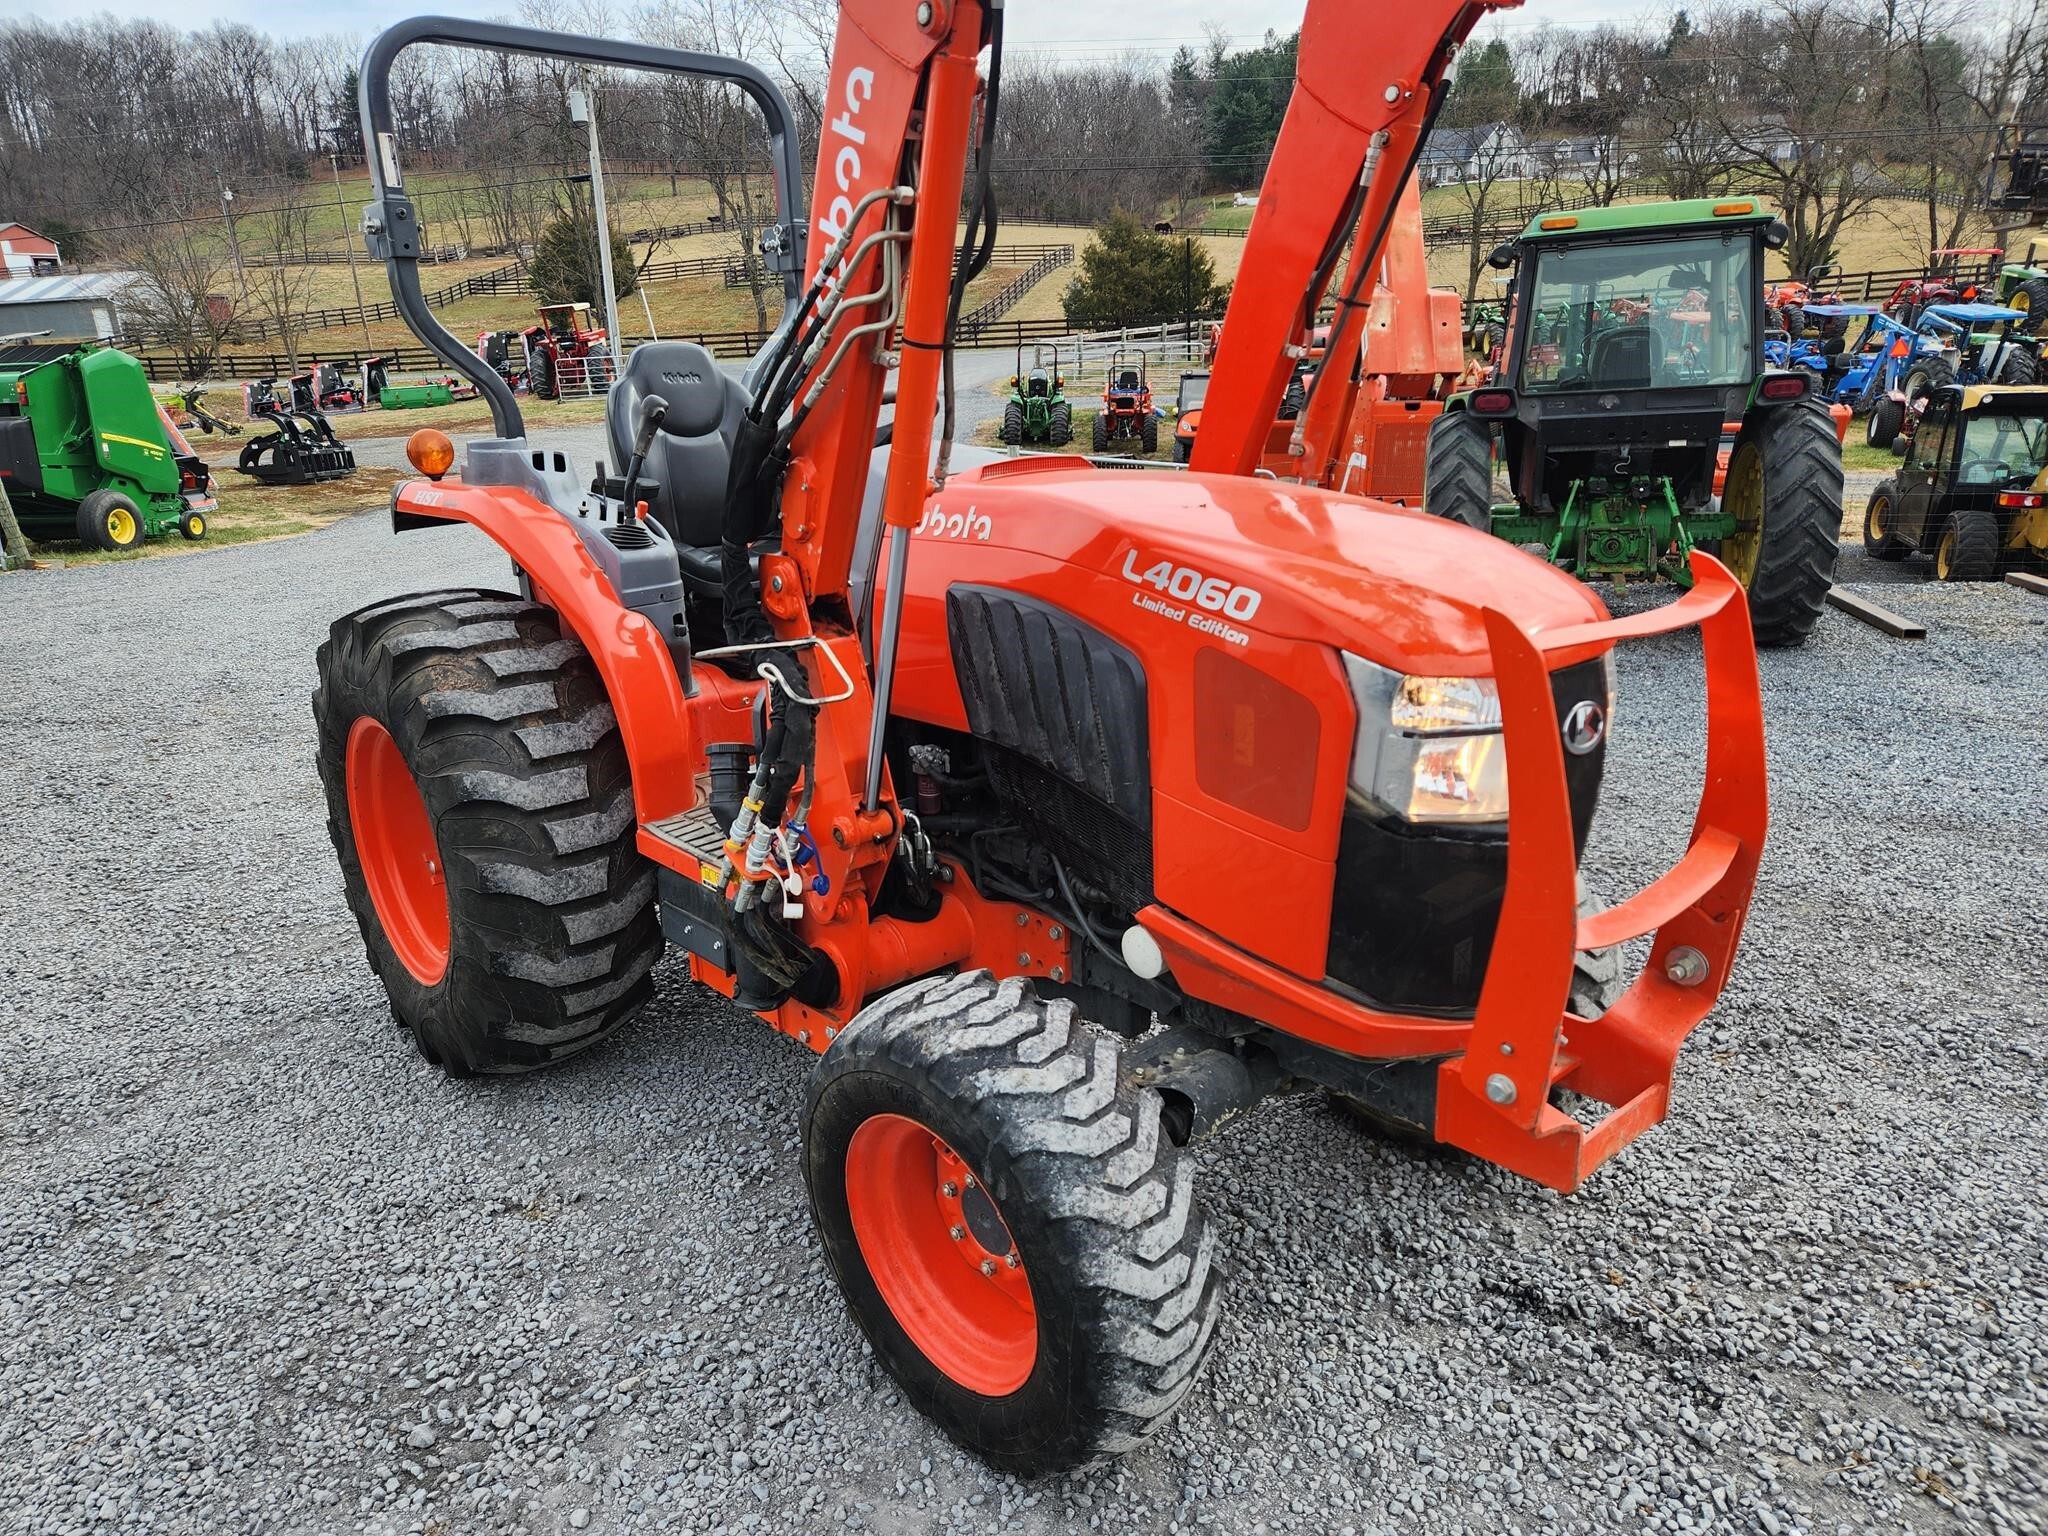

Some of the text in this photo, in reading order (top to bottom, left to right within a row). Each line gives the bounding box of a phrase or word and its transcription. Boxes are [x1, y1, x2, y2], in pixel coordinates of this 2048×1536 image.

[662, 371, 702, 385] Kubota
[412, 490, 444, 507] HST
[914, 503, 992, 541] ubota
[1121, 548, 1262, 622] L4060
[1132, 592, 1250, 646] Limited Edition
